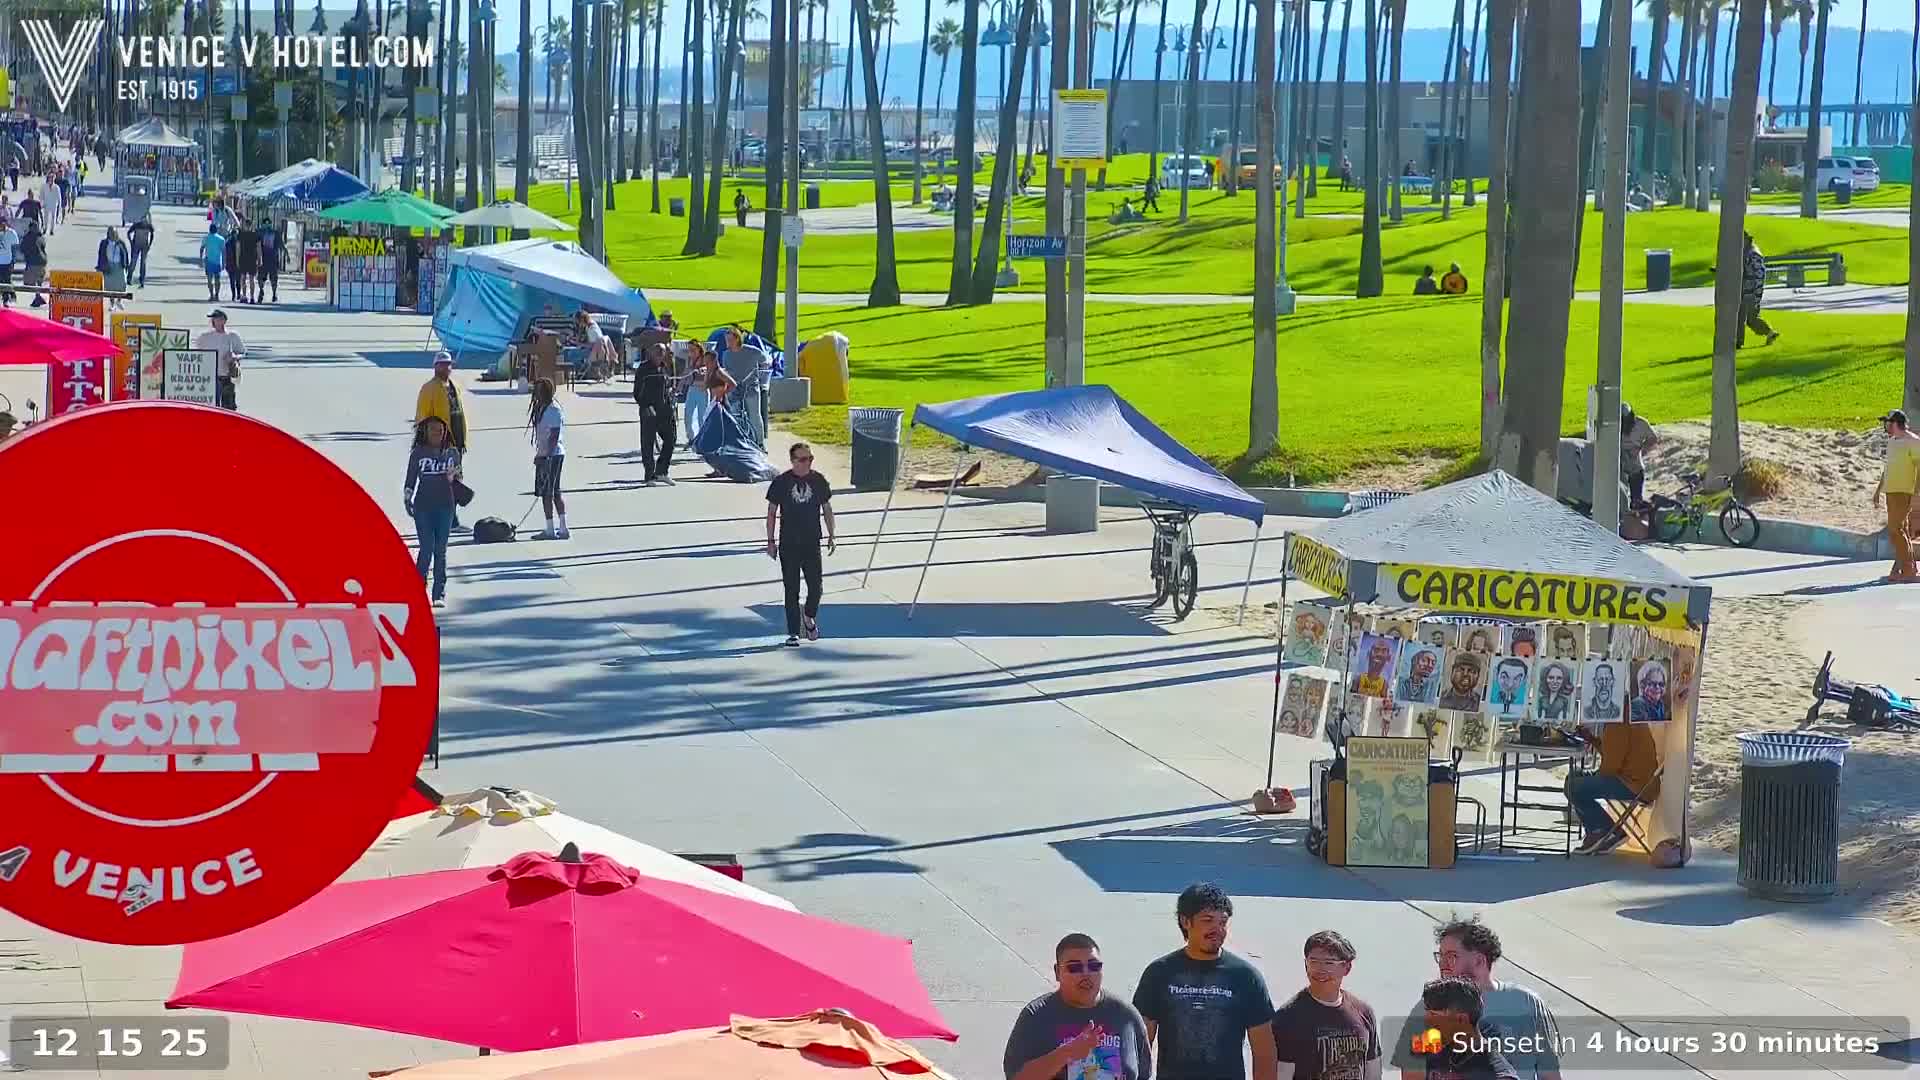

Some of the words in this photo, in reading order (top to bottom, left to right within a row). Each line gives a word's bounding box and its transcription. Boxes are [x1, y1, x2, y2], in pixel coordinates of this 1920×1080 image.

[330, 236, 385, 256] HENNA
[1010, 236, 1046, 249] Horizon
[1051, 237, 1063, 249] Av
[176, 353, 204, 362] VAPE
[1287, 539, 1345, 594] CARICATURES
[1397, 568, 1668, 622] CARICATURES
[73, 700, 240, 746] .com
[53, 847, 263, 901] VENICE
